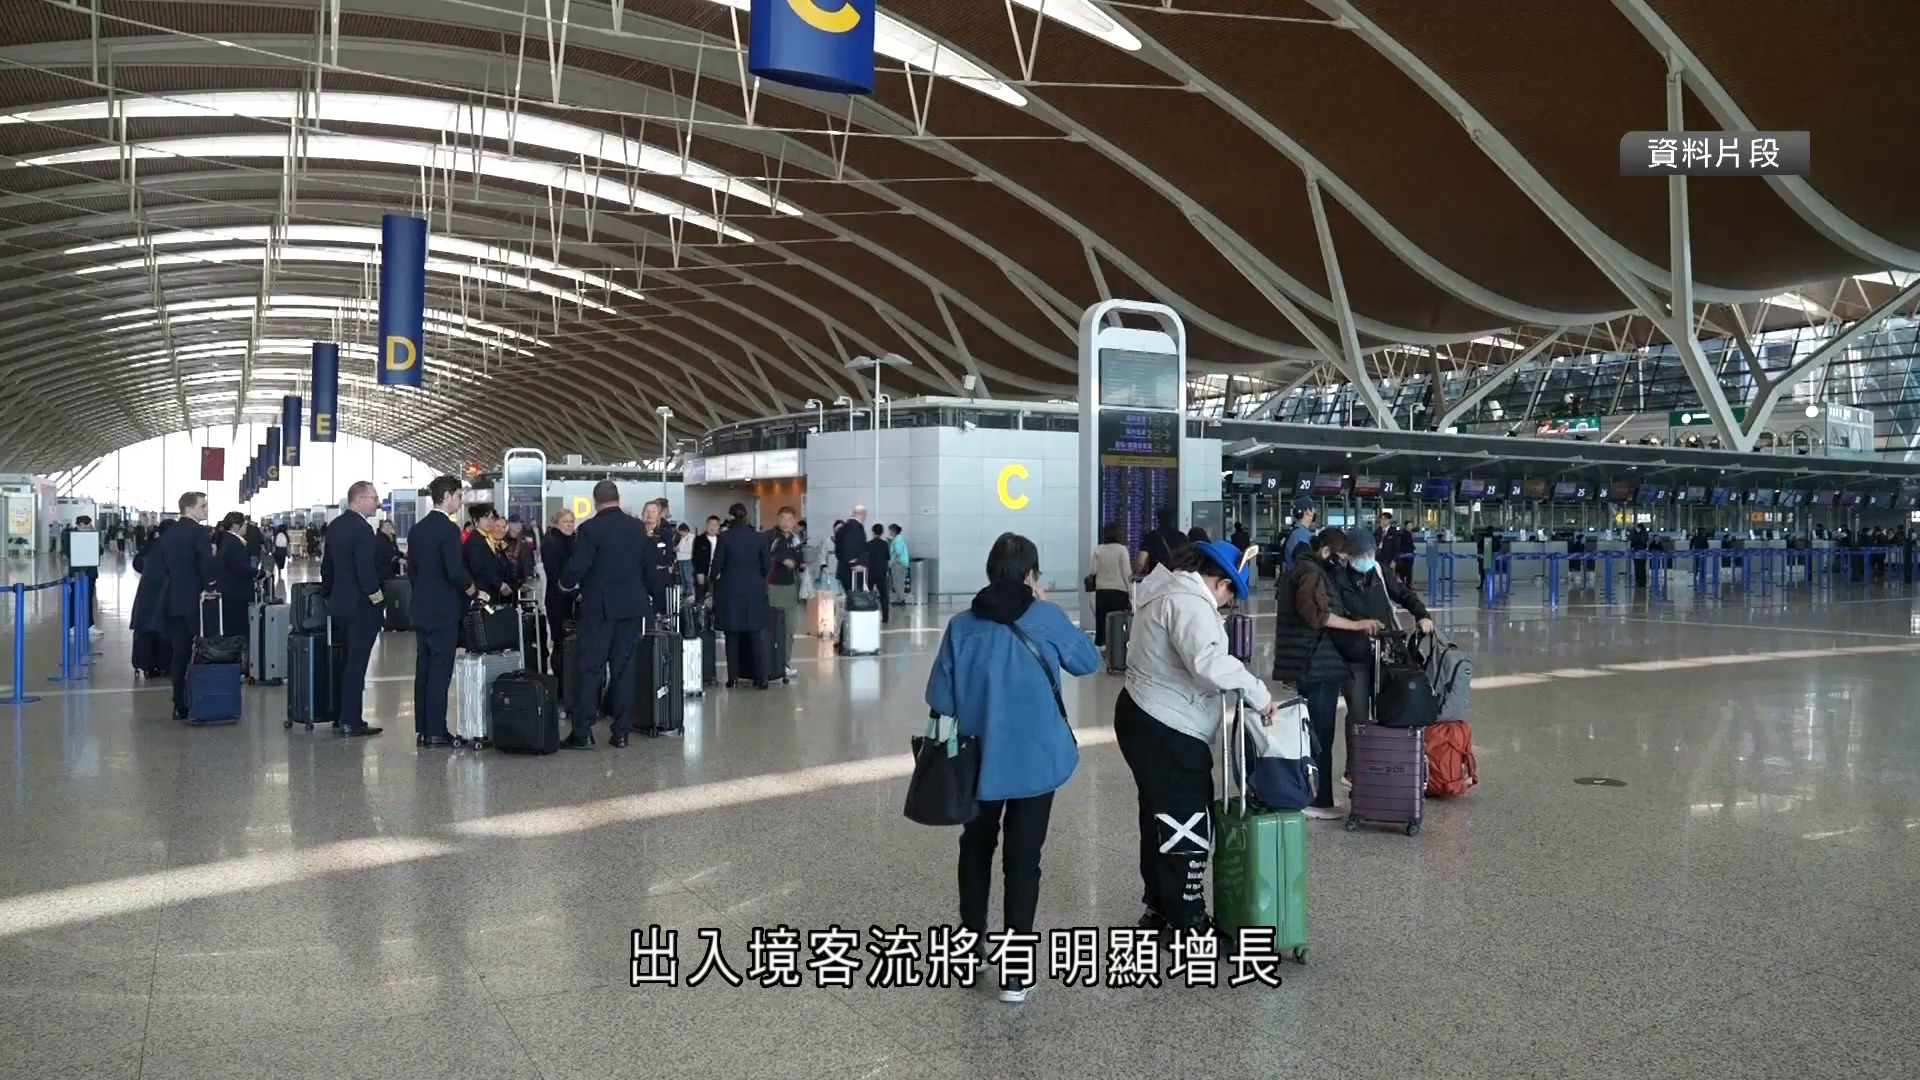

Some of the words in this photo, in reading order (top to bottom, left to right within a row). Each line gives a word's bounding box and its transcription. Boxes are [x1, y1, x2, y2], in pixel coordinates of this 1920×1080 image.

[386, 336, 416, 370] D
[316, 414, 331, 435] E
[286, 446, 297, 461] F
[997, 464, 1029, 510] C
[1267, 478, 1277, 489] 19
[1300, 480, 1311, 490] 20
[1383, 482, 1393, 492] 21
[1413, 483, 1423, 493] 22
[1486, 485, 1496, 495] 23
[574, 496, 592, 520] D
